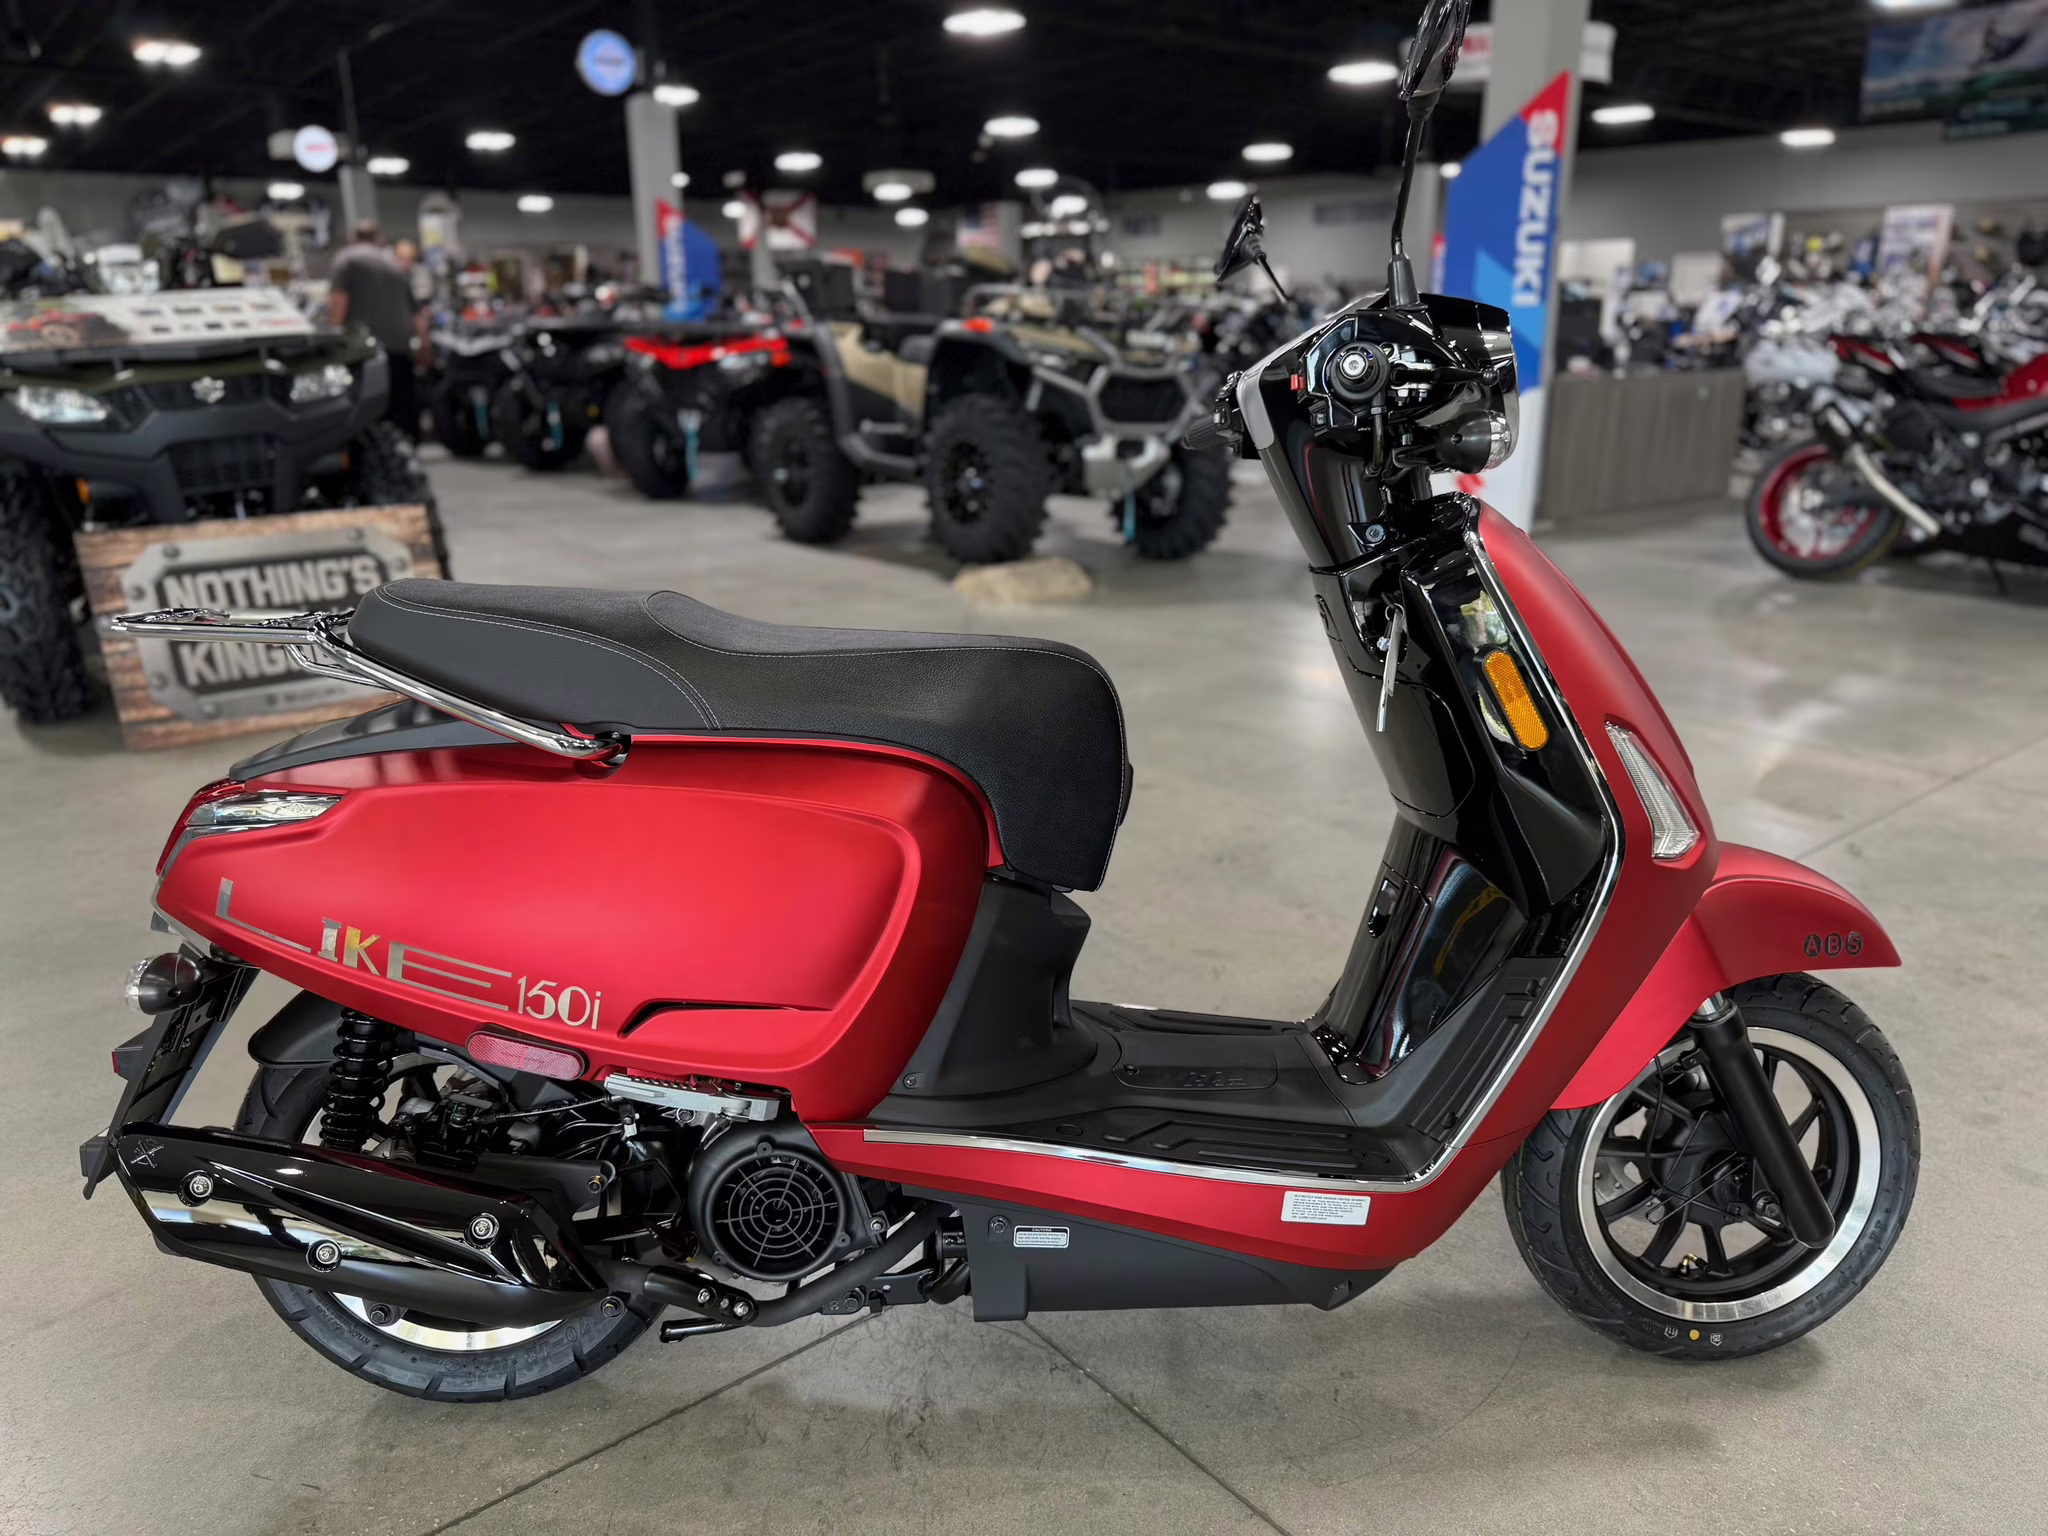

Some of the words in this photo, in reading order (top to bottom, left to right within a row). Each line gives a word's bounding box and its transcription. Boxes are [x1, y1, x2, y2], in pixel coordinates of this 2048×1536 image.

[1511, 108, 1560, 307] SUZUKI
[162, 555, 382, 609] NOTHING'S
[215, 877, 512, 1012] LIKE
[517, 975, 602, 1031] 150i
[1804, 931, 1864, 958] ABS
